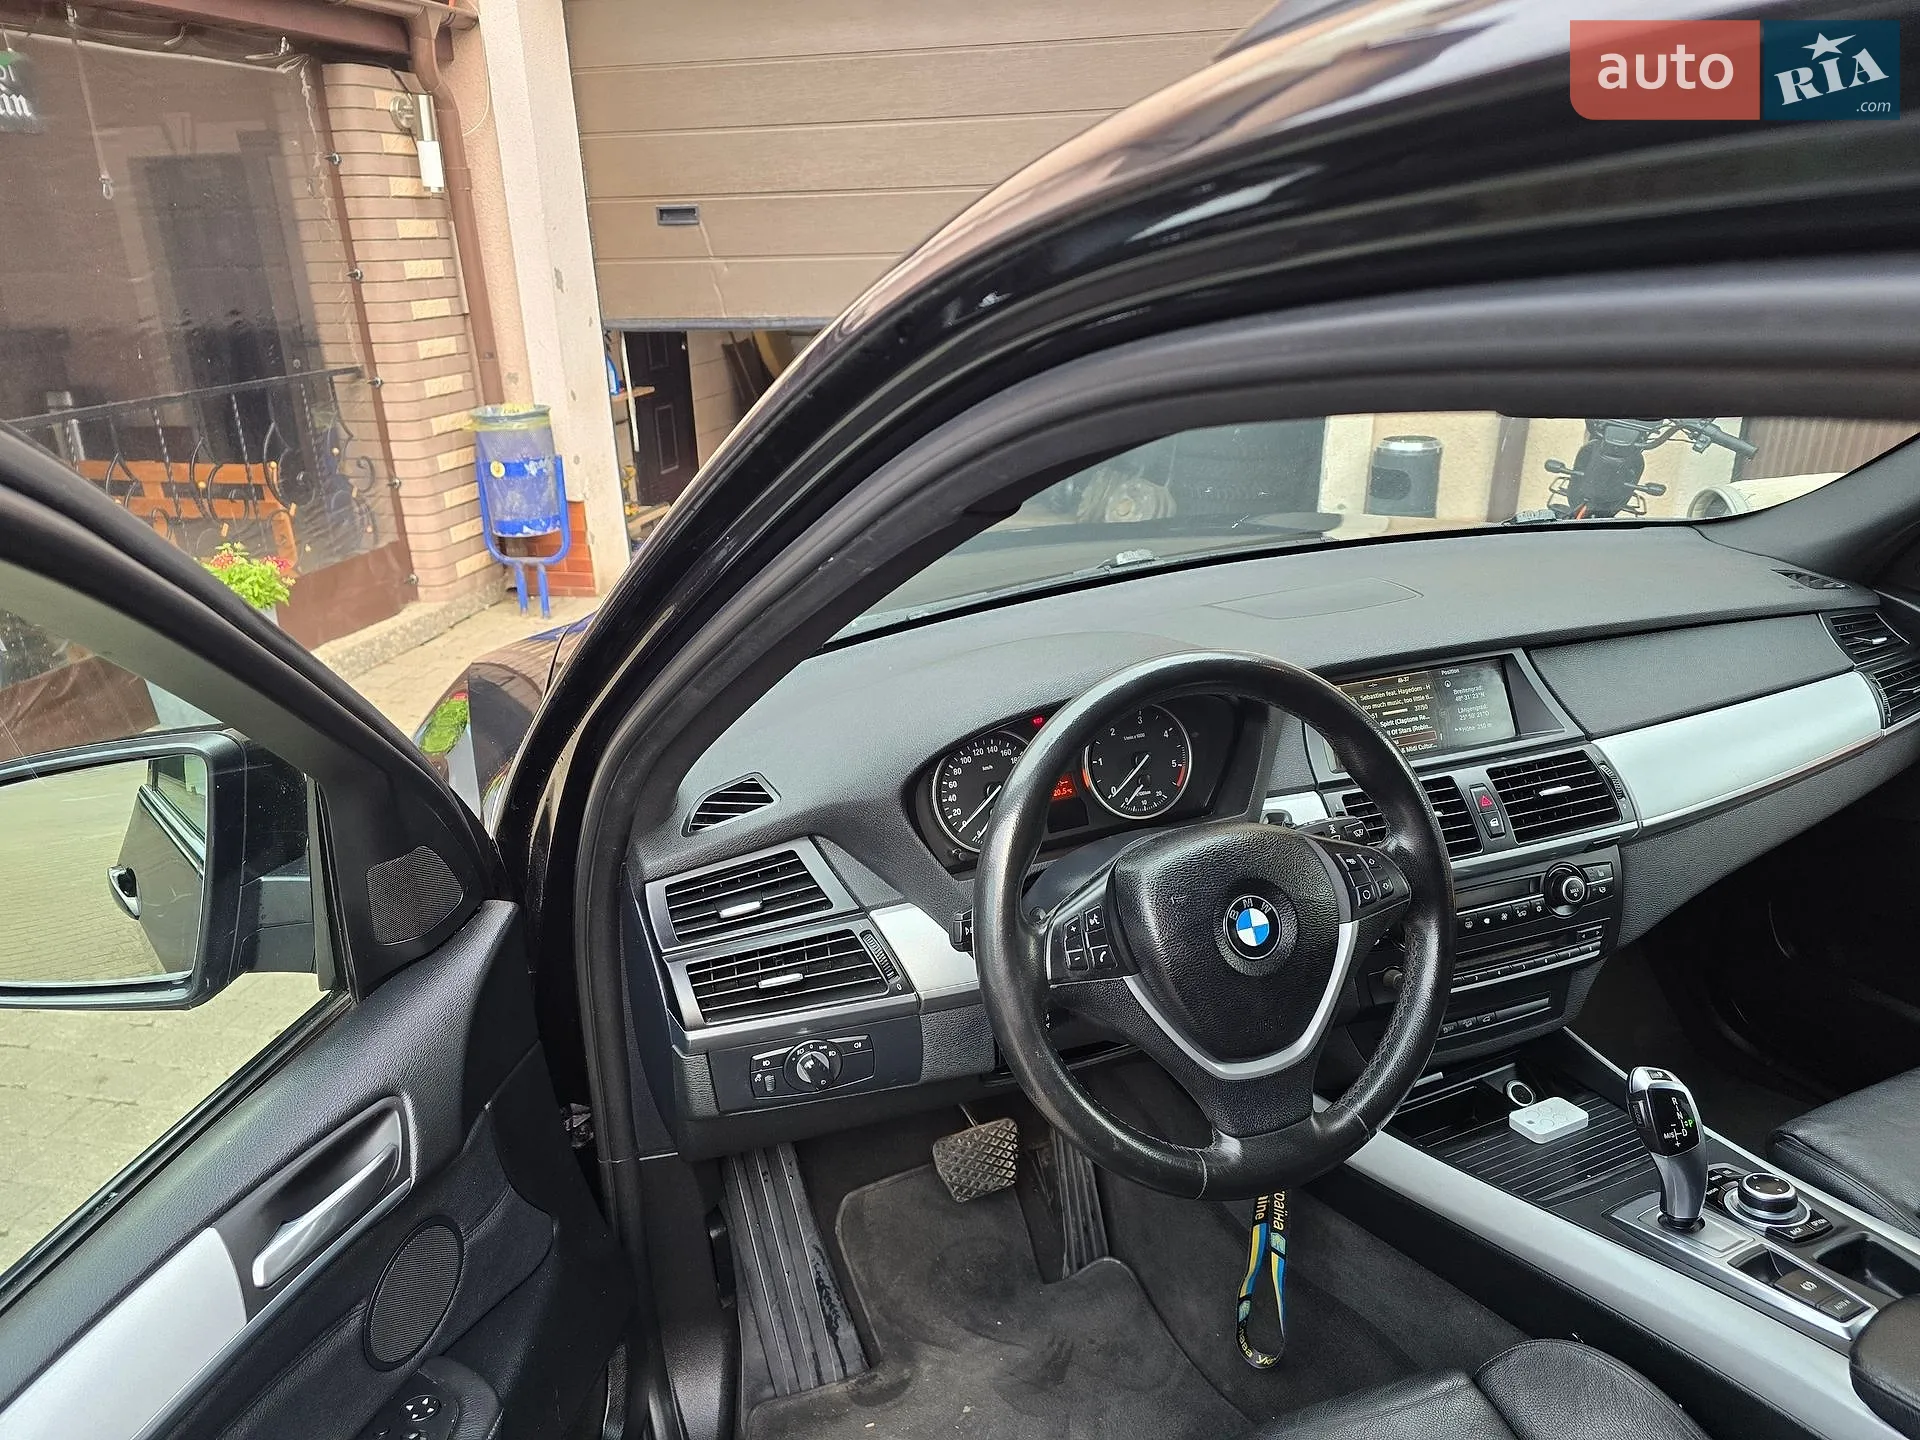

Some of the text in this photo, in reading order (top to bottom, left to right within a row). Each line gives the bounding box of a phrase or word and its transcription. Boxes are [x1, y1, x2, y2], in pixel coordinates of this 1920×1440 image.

[1137, 716, 1143, 724] 3
[1110, 728, 1116, 736] 2
[1163, 730, 1169, 738] 4
[972, 748, 984, 756] 120
[986, 745, 998, 753] 140
[1000, 748, 1012, 757] 160
[960, 756, 972, 764] 100
[1171, 759, 1177, 768] 5
[953, 767, 962, 776] 80
[948, 780, 957, 789] 60
[948, 794, 957, 803] 40
[952, 808, 961, 816] 20
[1229, 898, 1272, 920] BMW
[1671, 1097, 1678, 1105] R
[1676, 1111, 1683, 1120] N
[1687, 1119, 1693, 1127] P
[1681, 1128, 1688, 1137] D
